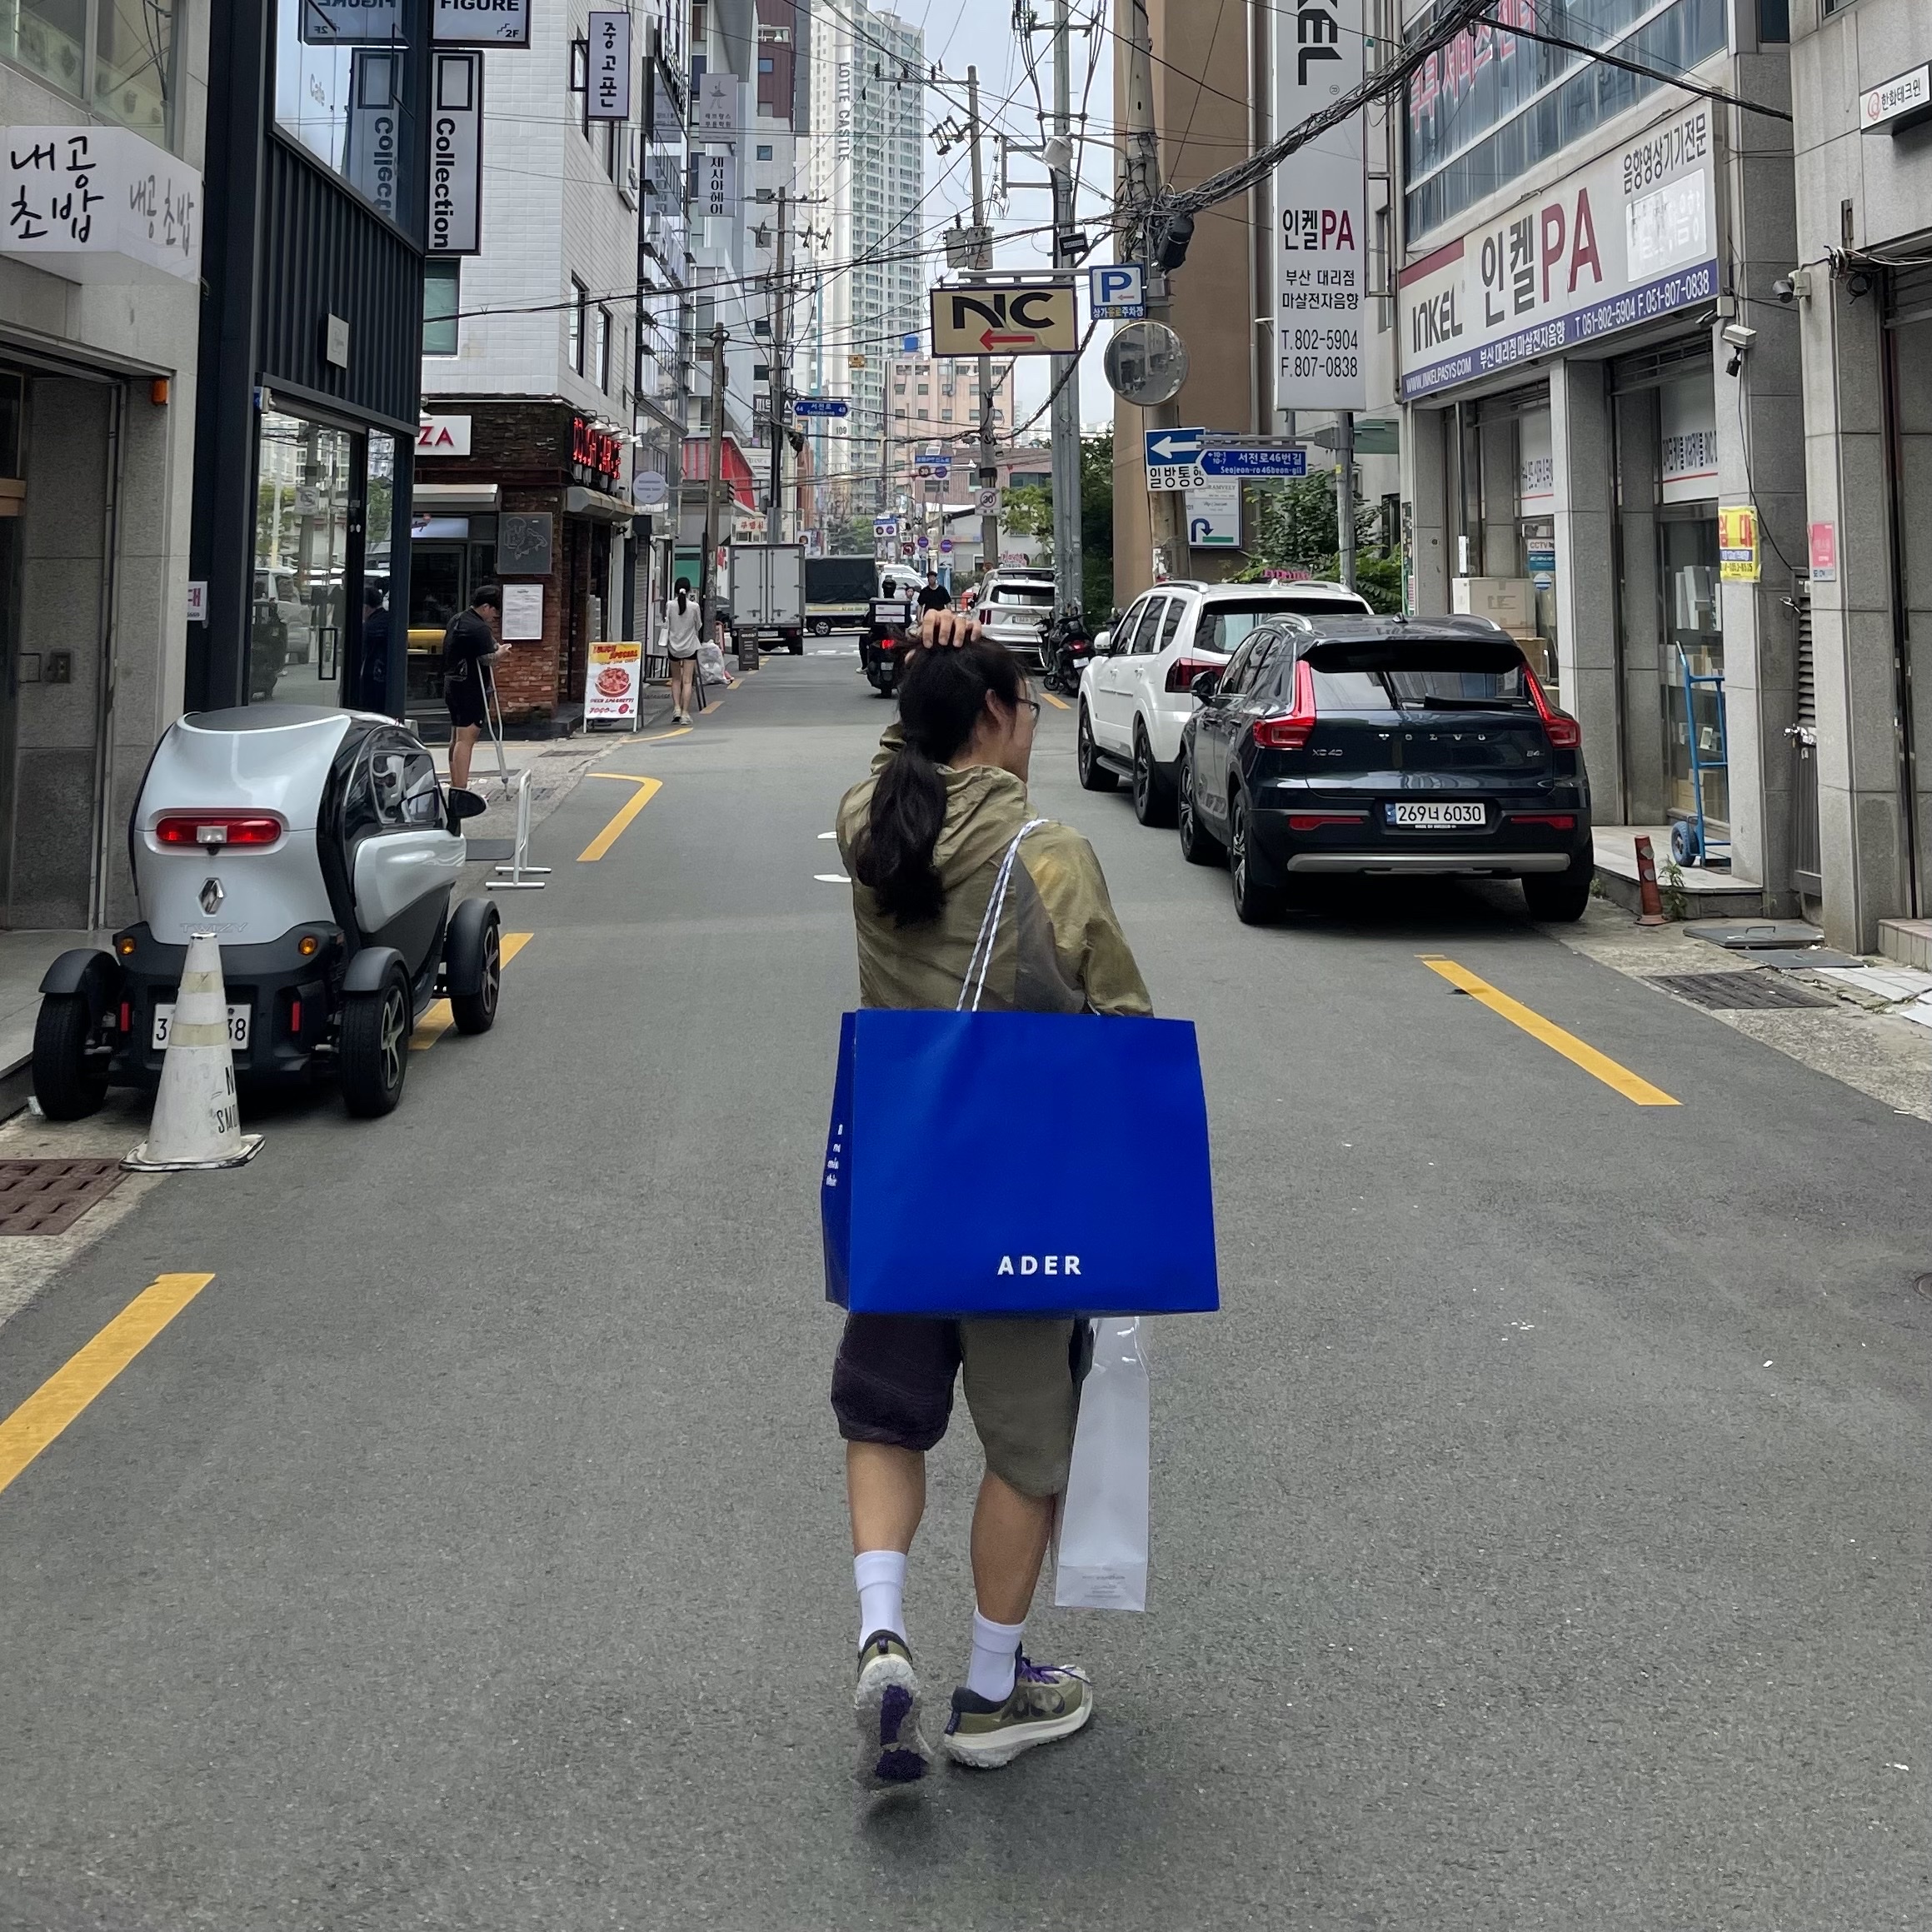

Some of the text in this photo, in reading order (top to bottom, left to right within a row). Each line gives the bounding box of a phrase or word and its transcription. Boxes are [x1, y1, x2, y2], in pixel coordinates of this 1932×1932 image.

[599, 22, 617, 107] 중고폰
[837, 62, 851, 161] LOTTE CASTLE
[11, 135, 97, 189] 내공
[434, 118, 456, 248] Collection
[10, 184, 104, 242] 초밥
[130, 174, 195, 257] 내공 초밥
[1101, 271, 1132, 302] P
[1286, 269, 1355, 287] 부산 대리점
[952, 292, 1056, 329] NC
[1412, 284, 1463, 353] INKEL
[1281, 329, 1359, 352] T.802-5904
[1480, 346, 1495, 370] 부산
[1495, 334, 1517, 364] 대리점
[1281, 357, 1359, 378] F.807-0838
[1238, 452, 1302, 466] 서전로46번길
[1530, 542, 1547, 550] CCTV
[180, 922, 248, 933] TWIZY
[998, 1256, 1082, 1276] ADER
